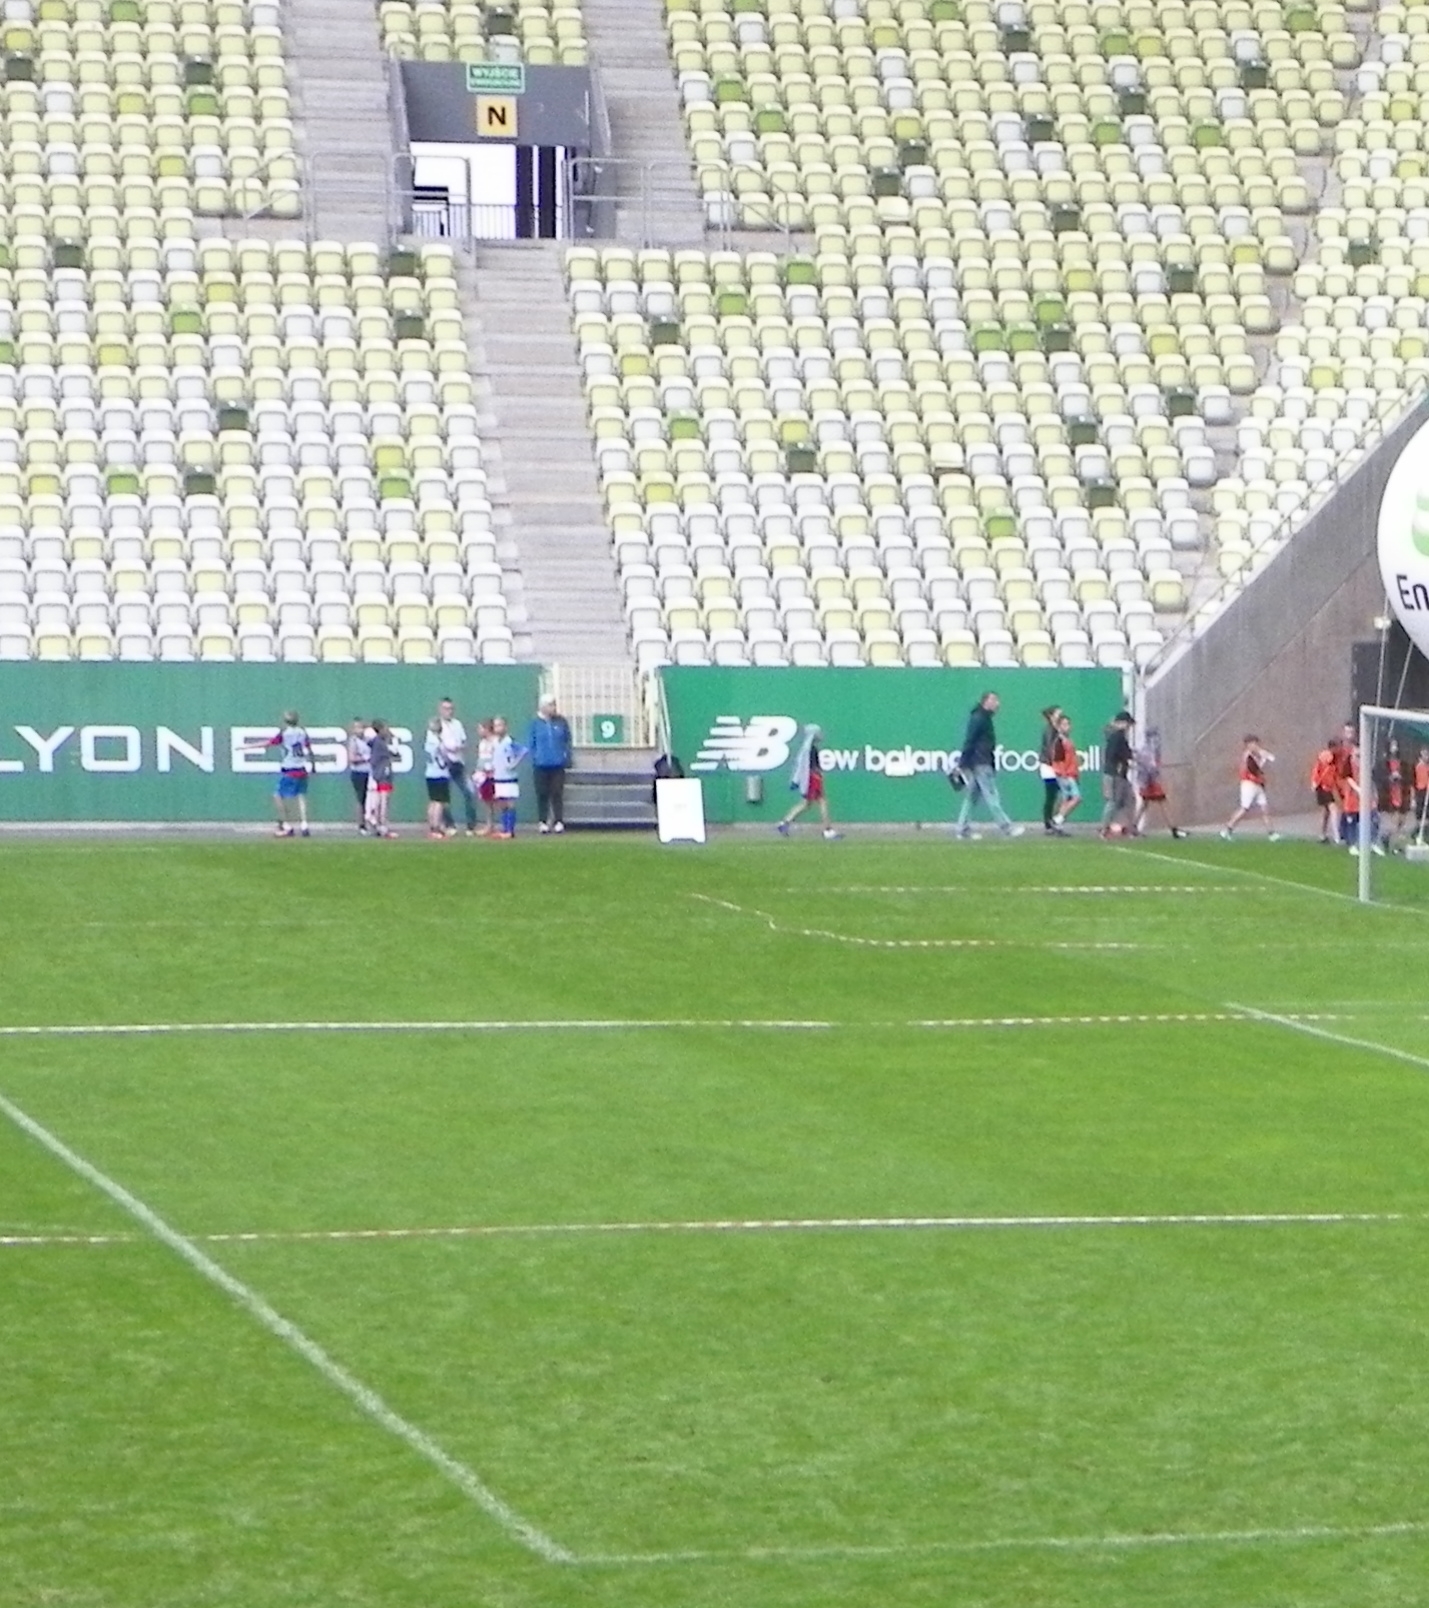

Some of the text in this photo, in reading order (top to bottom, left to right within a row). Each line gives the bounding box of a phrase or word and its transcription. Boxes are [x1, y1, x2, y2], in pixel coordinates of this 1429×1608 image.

[488, 105, 506, 126] N
[600, 720, 616, 739] 9
[818, 743, 1101, 773] ew balanc fooall
